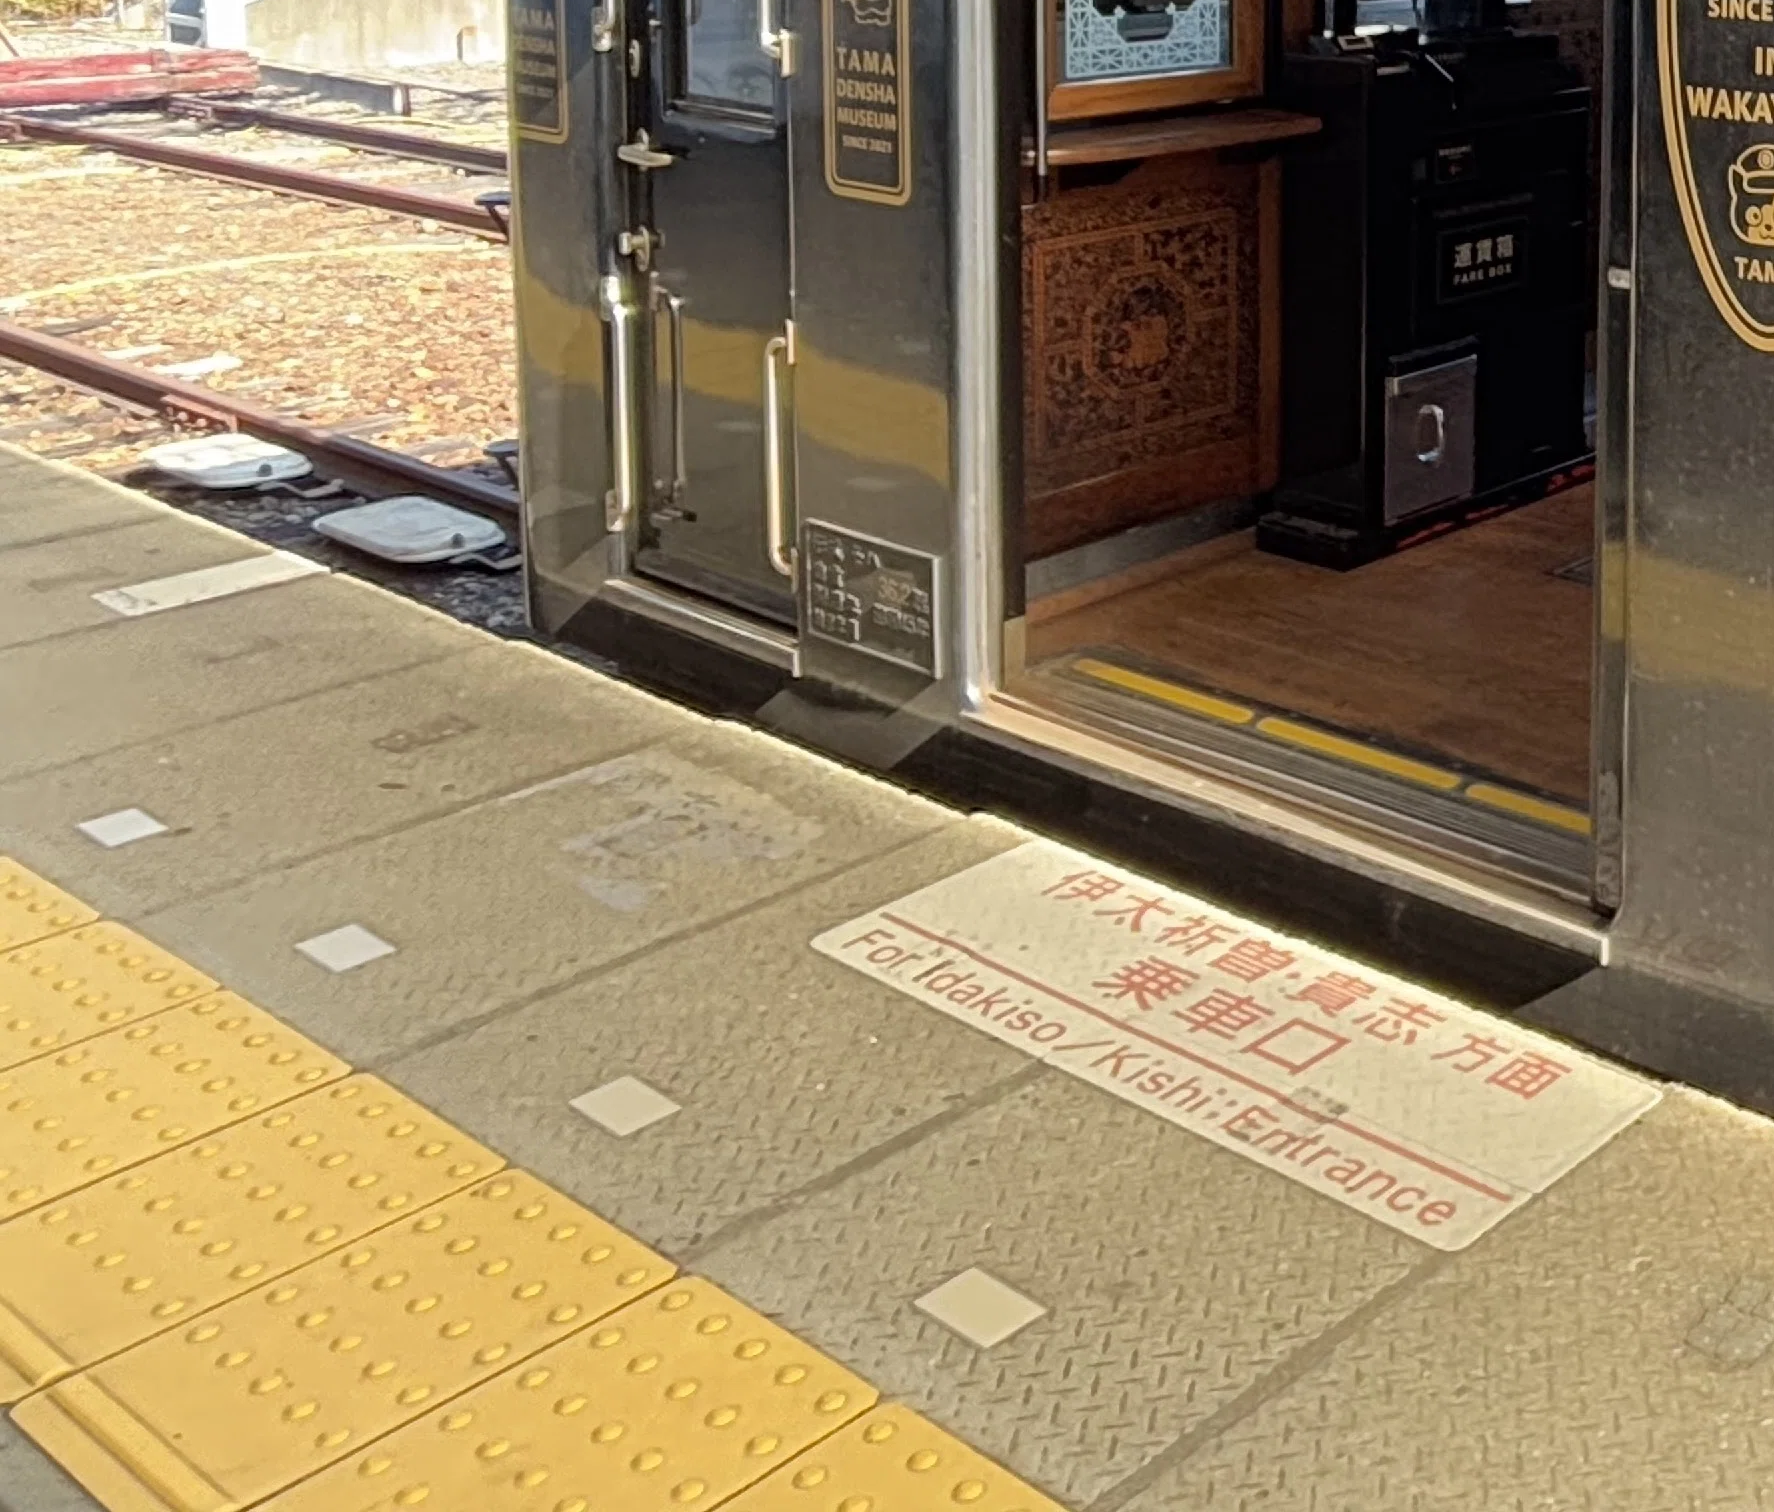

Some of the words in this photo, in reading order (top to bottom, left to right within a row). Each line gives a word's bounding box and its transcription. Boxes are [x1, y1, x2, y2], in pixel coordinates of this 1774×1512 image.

[836, 47, 895, 76] TAMA
[836, 78, 896, 105] DENSHA
[836, 107, 896, 131] MUSEUM
[841, 928, 927, 971] For
[1091, 955, 1352, 1076] 乗車口
